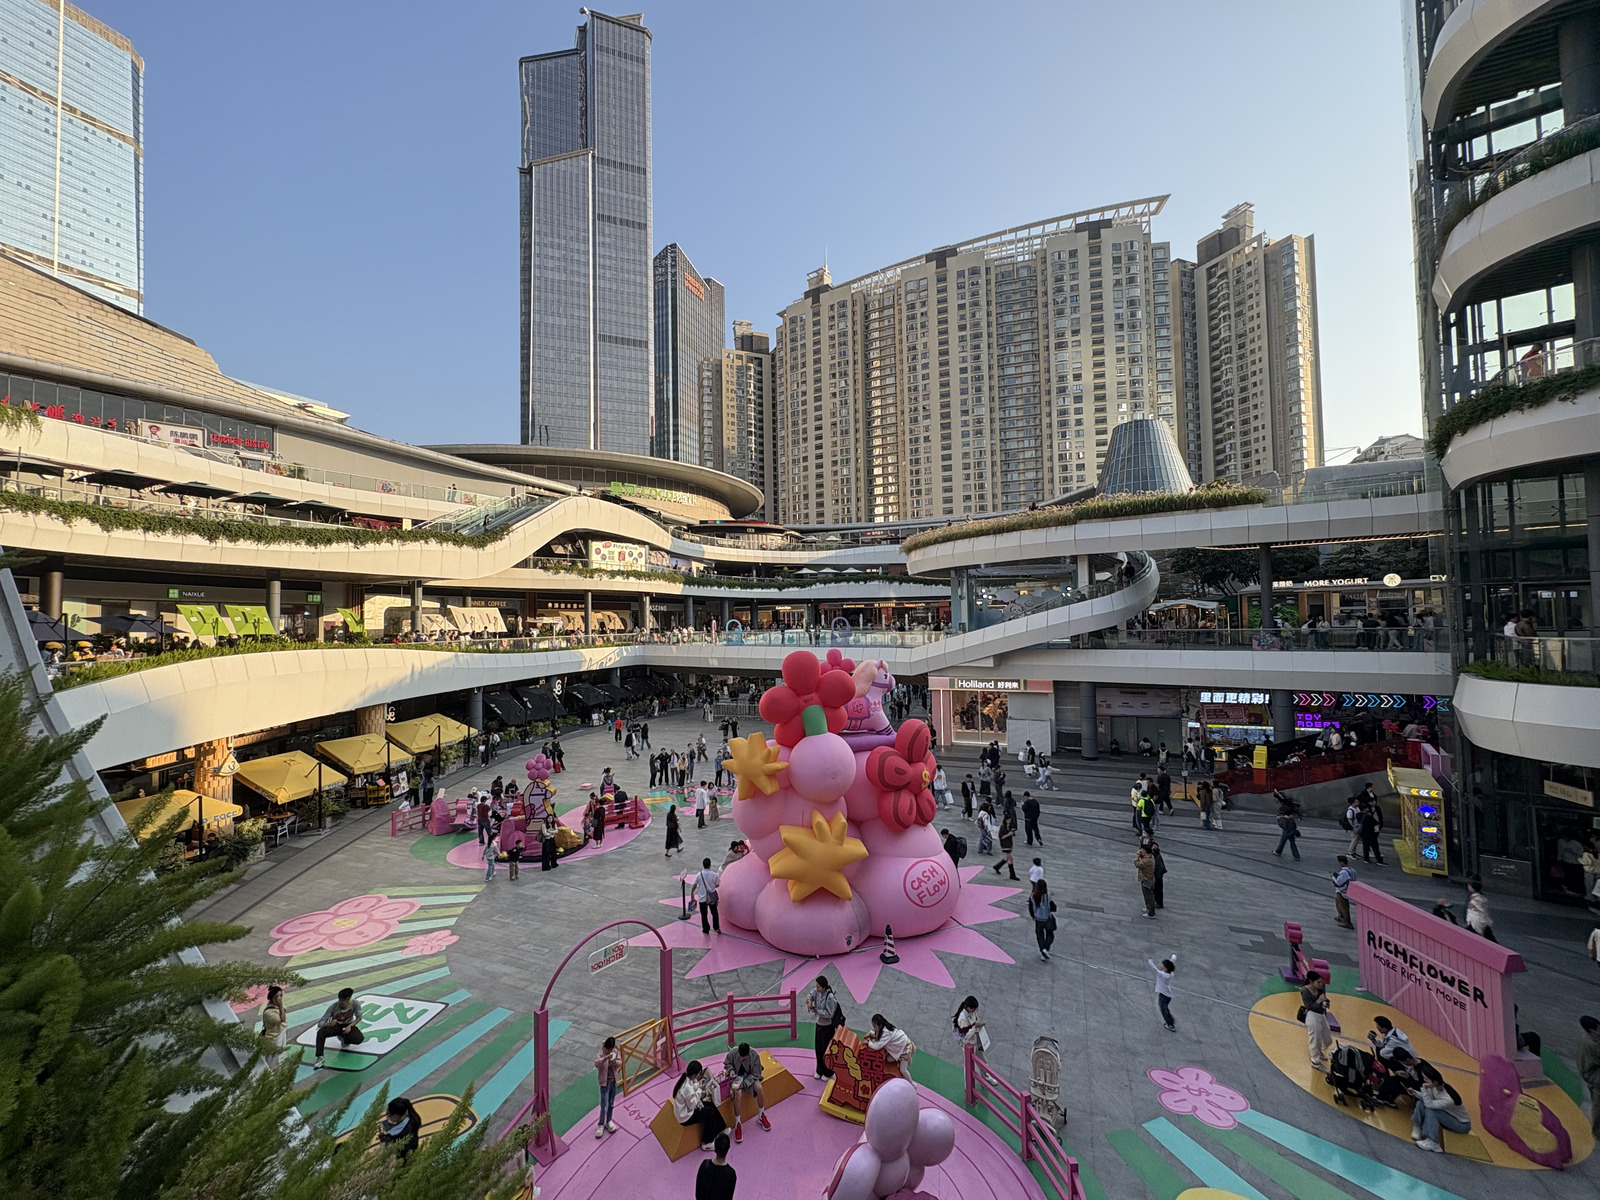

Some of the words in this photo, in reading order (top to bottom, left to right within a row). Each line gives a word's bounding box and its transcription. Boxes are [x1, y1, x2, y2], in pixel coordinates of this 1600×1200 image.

[245, 438, 270, 450] BISTRO
[1332, 577, 1369, 586] YOGURT
[649, 604, 668, 612] ASCINO
[997, 681, 1019, 689] 好利来
[1200, 692, 1270, 704] 里面更精彩!
[1296, 713, 1322, 721] TOY
[910, 865, 939, 891] CASH
[917, 875, 947, 904] FLOW
[1367, 929, 1488, 1009] RICHFLOWER
[1373, 952, 1398, 973] MORE
[1401, 965, 1421, 987] RICH
[1436, 986, 1467, 1012] MORE
[623, 1103, 651, 1130] TART
